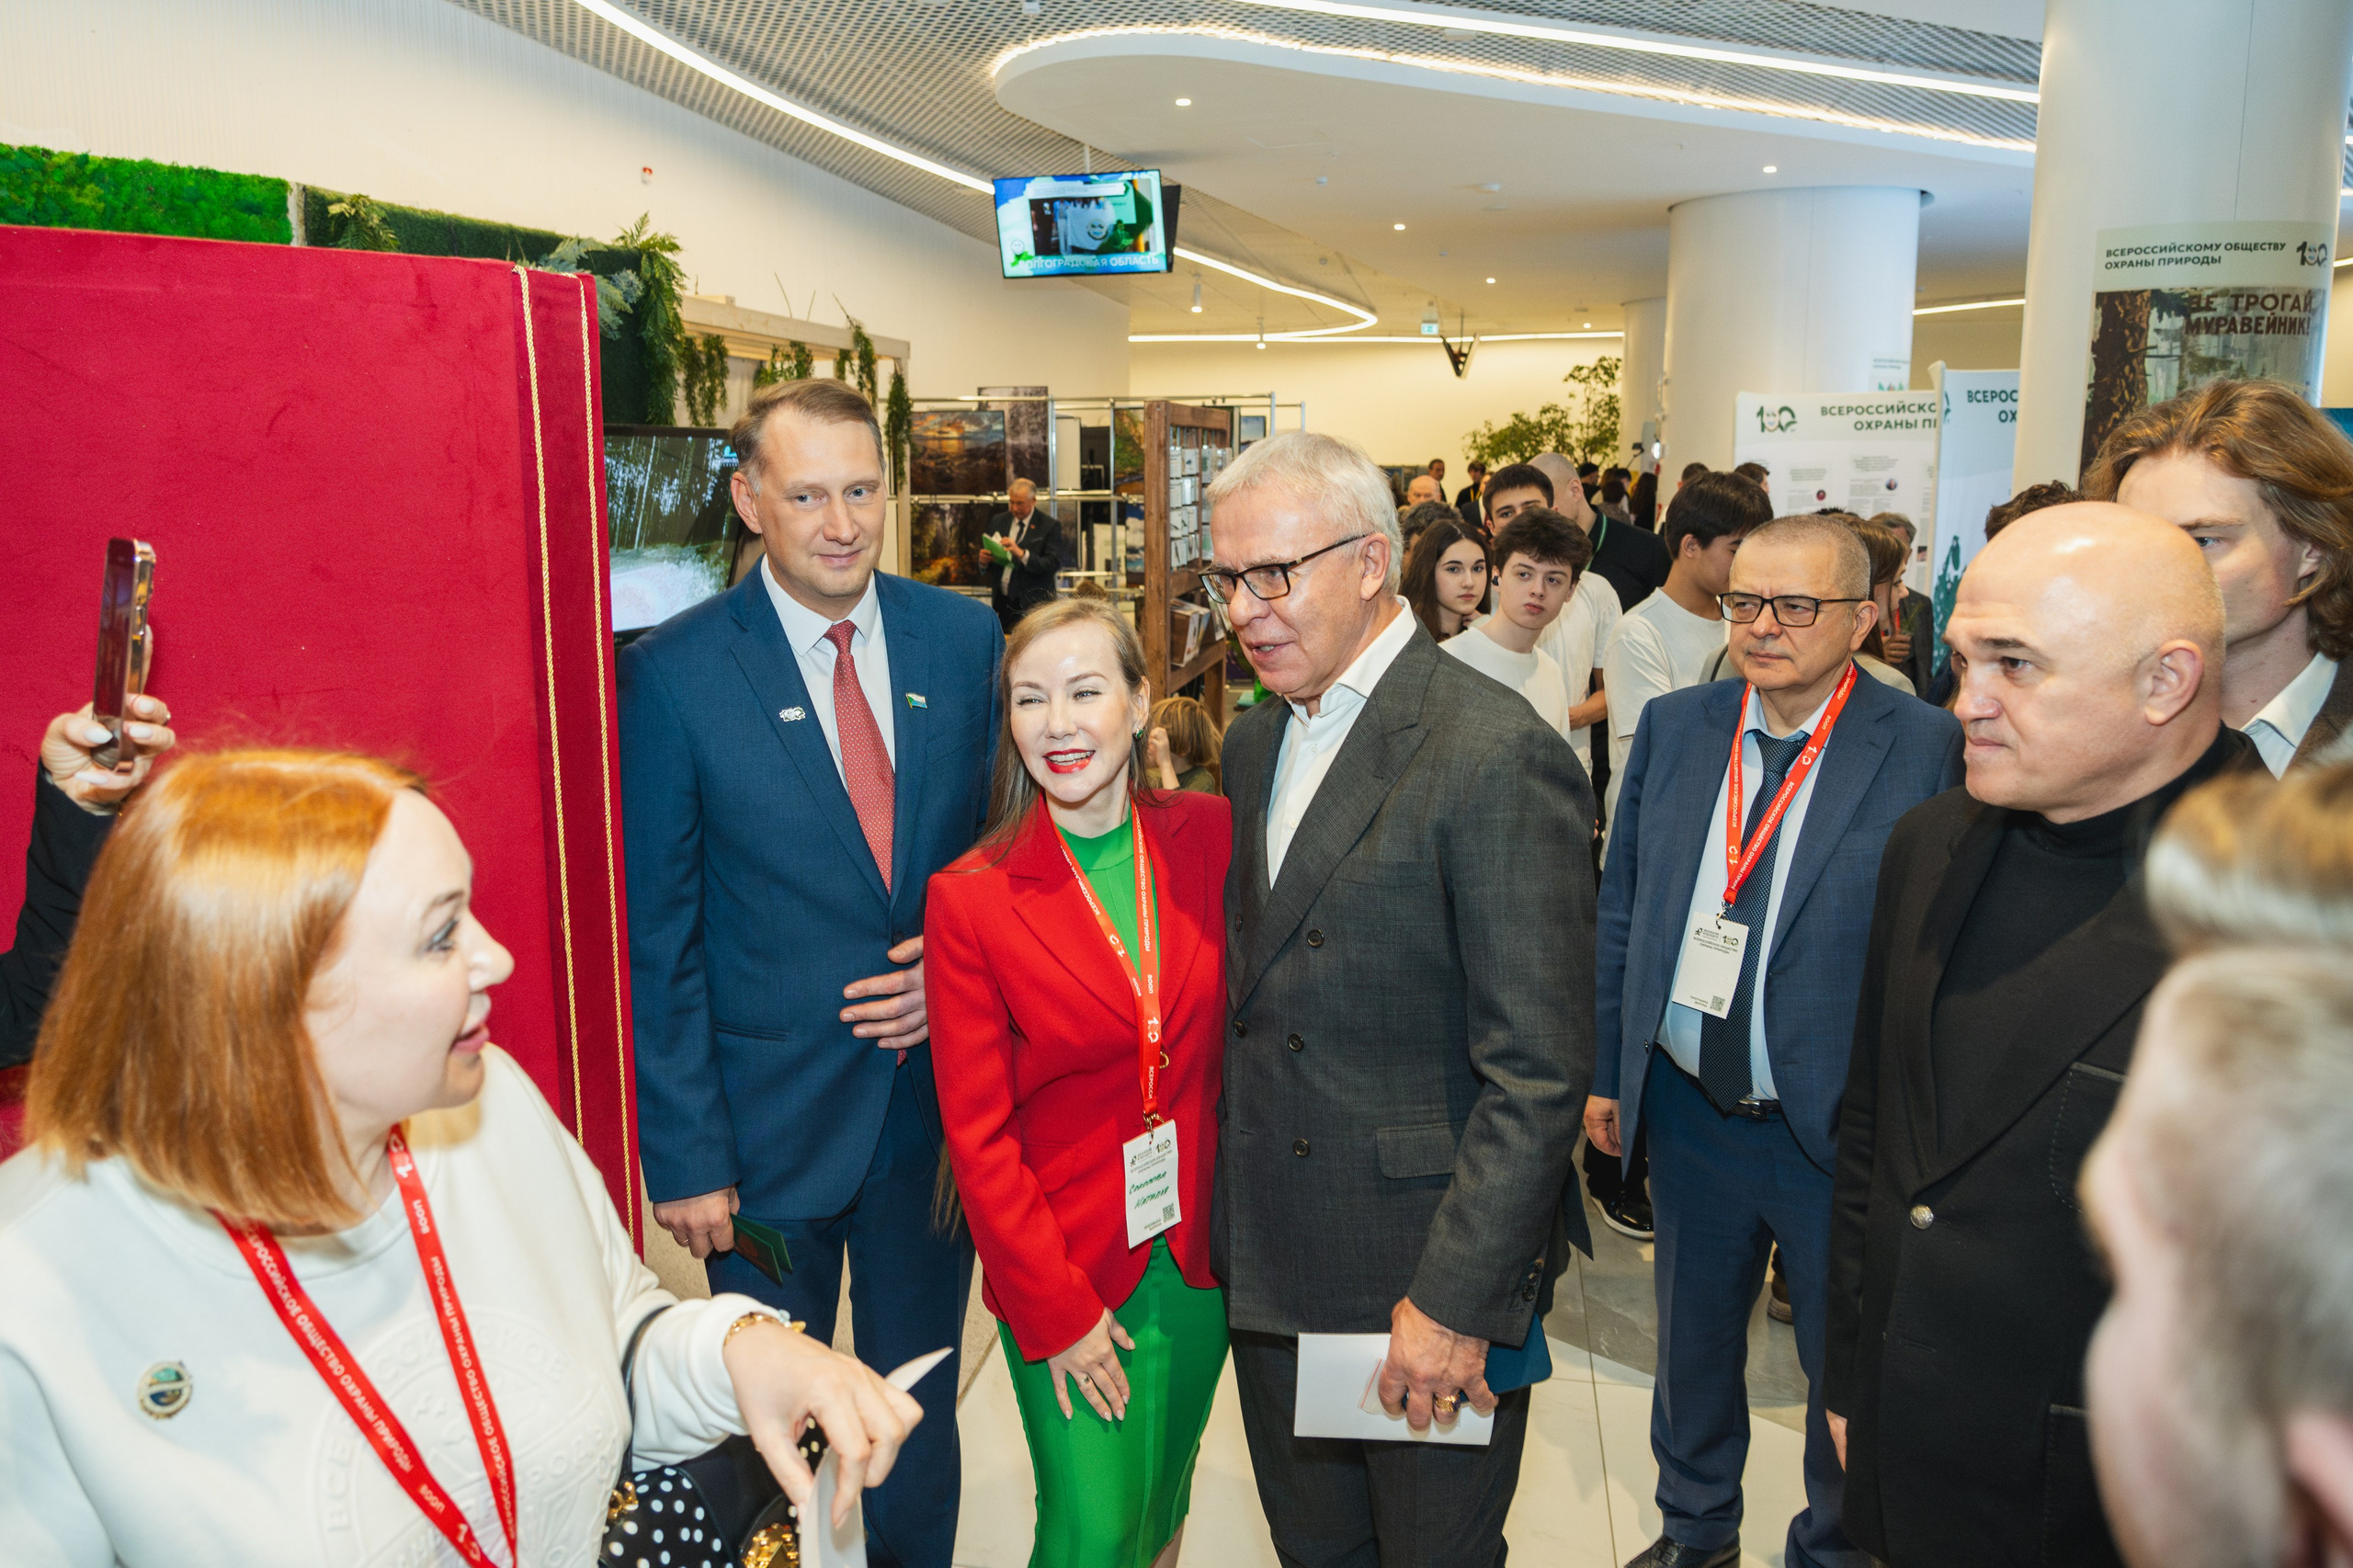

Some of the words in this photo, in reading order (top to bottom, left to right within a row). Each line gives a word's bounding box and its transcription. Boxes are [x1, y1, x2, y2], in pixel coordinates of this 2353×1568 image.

[1018, 257, 1108, 269] ВОЛГОГРАДСКАЯ
[1109, 256, 1159, 267] ОБЛАСТЬ
[2105, 258, 2154, 270] ОХРАНЫ
[2158, 256, 2222, 267] ПРИРОДЫ
[2106, 242, 2222, 258] ВСЕРОССИЙСКОМУ
[2224, 242, 2286, 253] ОБЩЕСТВУ
[2185, 312, 2311, 335] МУРАВЕЙНИК!
[1854, 419, 1917, 431] ОХРАНЫ
[1823, 715, 1831, 730] ВООП
[1732, 782, 1740, 828] ВСЕРОССИЙСКОЕ
[1768, 781, 1795, 824] ВСЕРОССИЙСКОЕ
[1752, 823, 1770, 852] ОБЩЕСТВО
[1740, 851, 1755, 873] ОХРАНЫ
[1142, 918, 1151, 952] ПРИРОДЫ
[1132, 977, 1142, 997] ВООП
[413, 1199, 430, 1234] ВООП
[430, 1256, 455, 1317] ПРИРОДЫ
[448, 1316, 472, 1369] ОХРАНЫ
[296, 1314, 344, 1378] ОБЩЕСТВО
[339, 1373, 378, 1422] ОХРАНЫ
[374, 1419, 413, 1472] ПРИРОДЫ
[464, 1369, 494, 1437] ОБЩЕСТВО
[418, 1483, 446, 1514] ВООП
